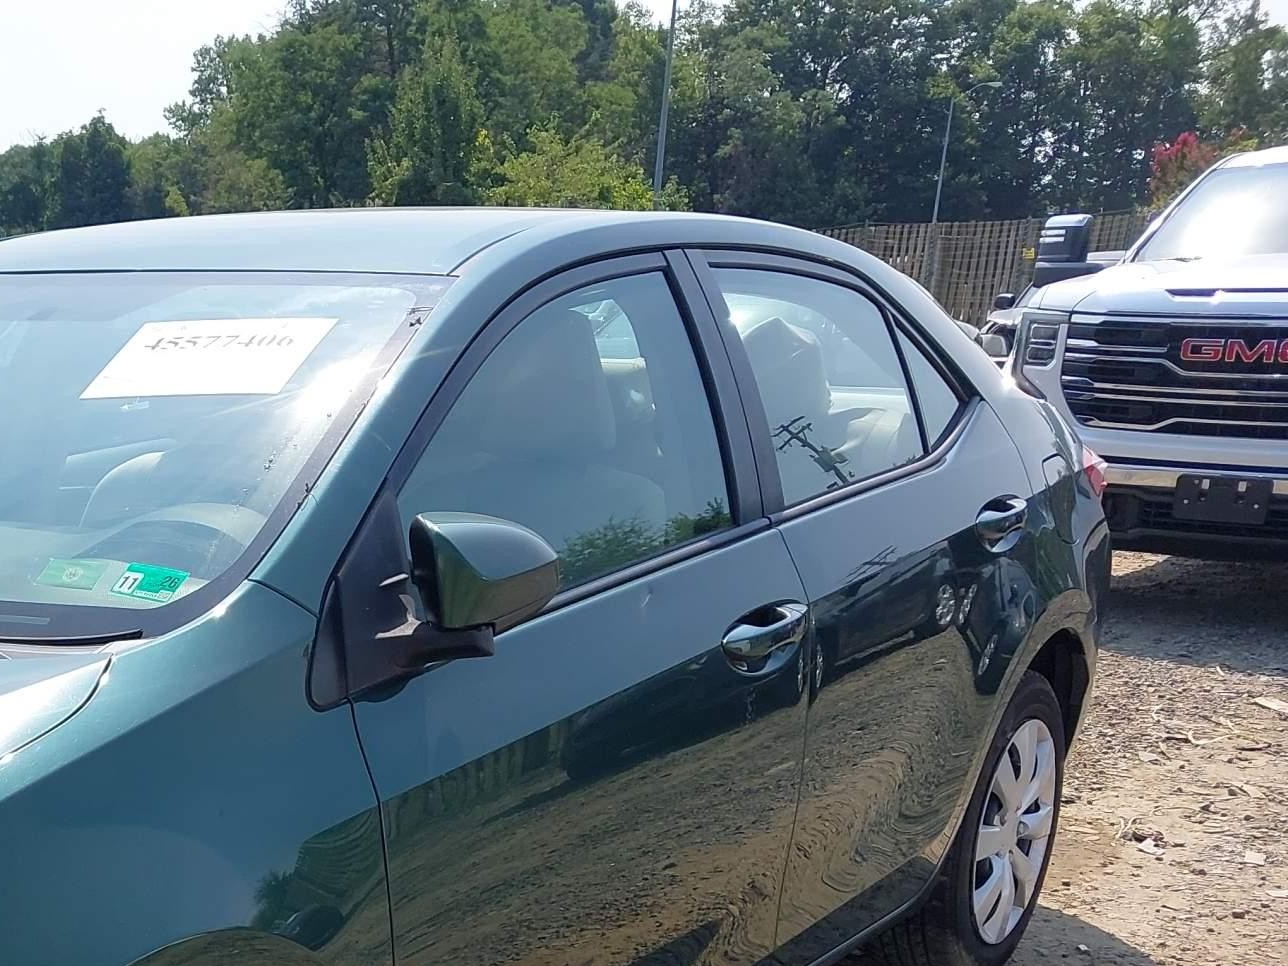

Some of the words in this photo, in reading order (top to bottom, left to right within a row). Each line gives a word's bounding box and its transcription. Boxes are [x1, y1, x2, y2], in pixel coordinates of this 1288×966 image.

[1179, 337, 1288, 363] GM
[118, 575, 140, 591] 11
[158, 575, 181, 590] 26
